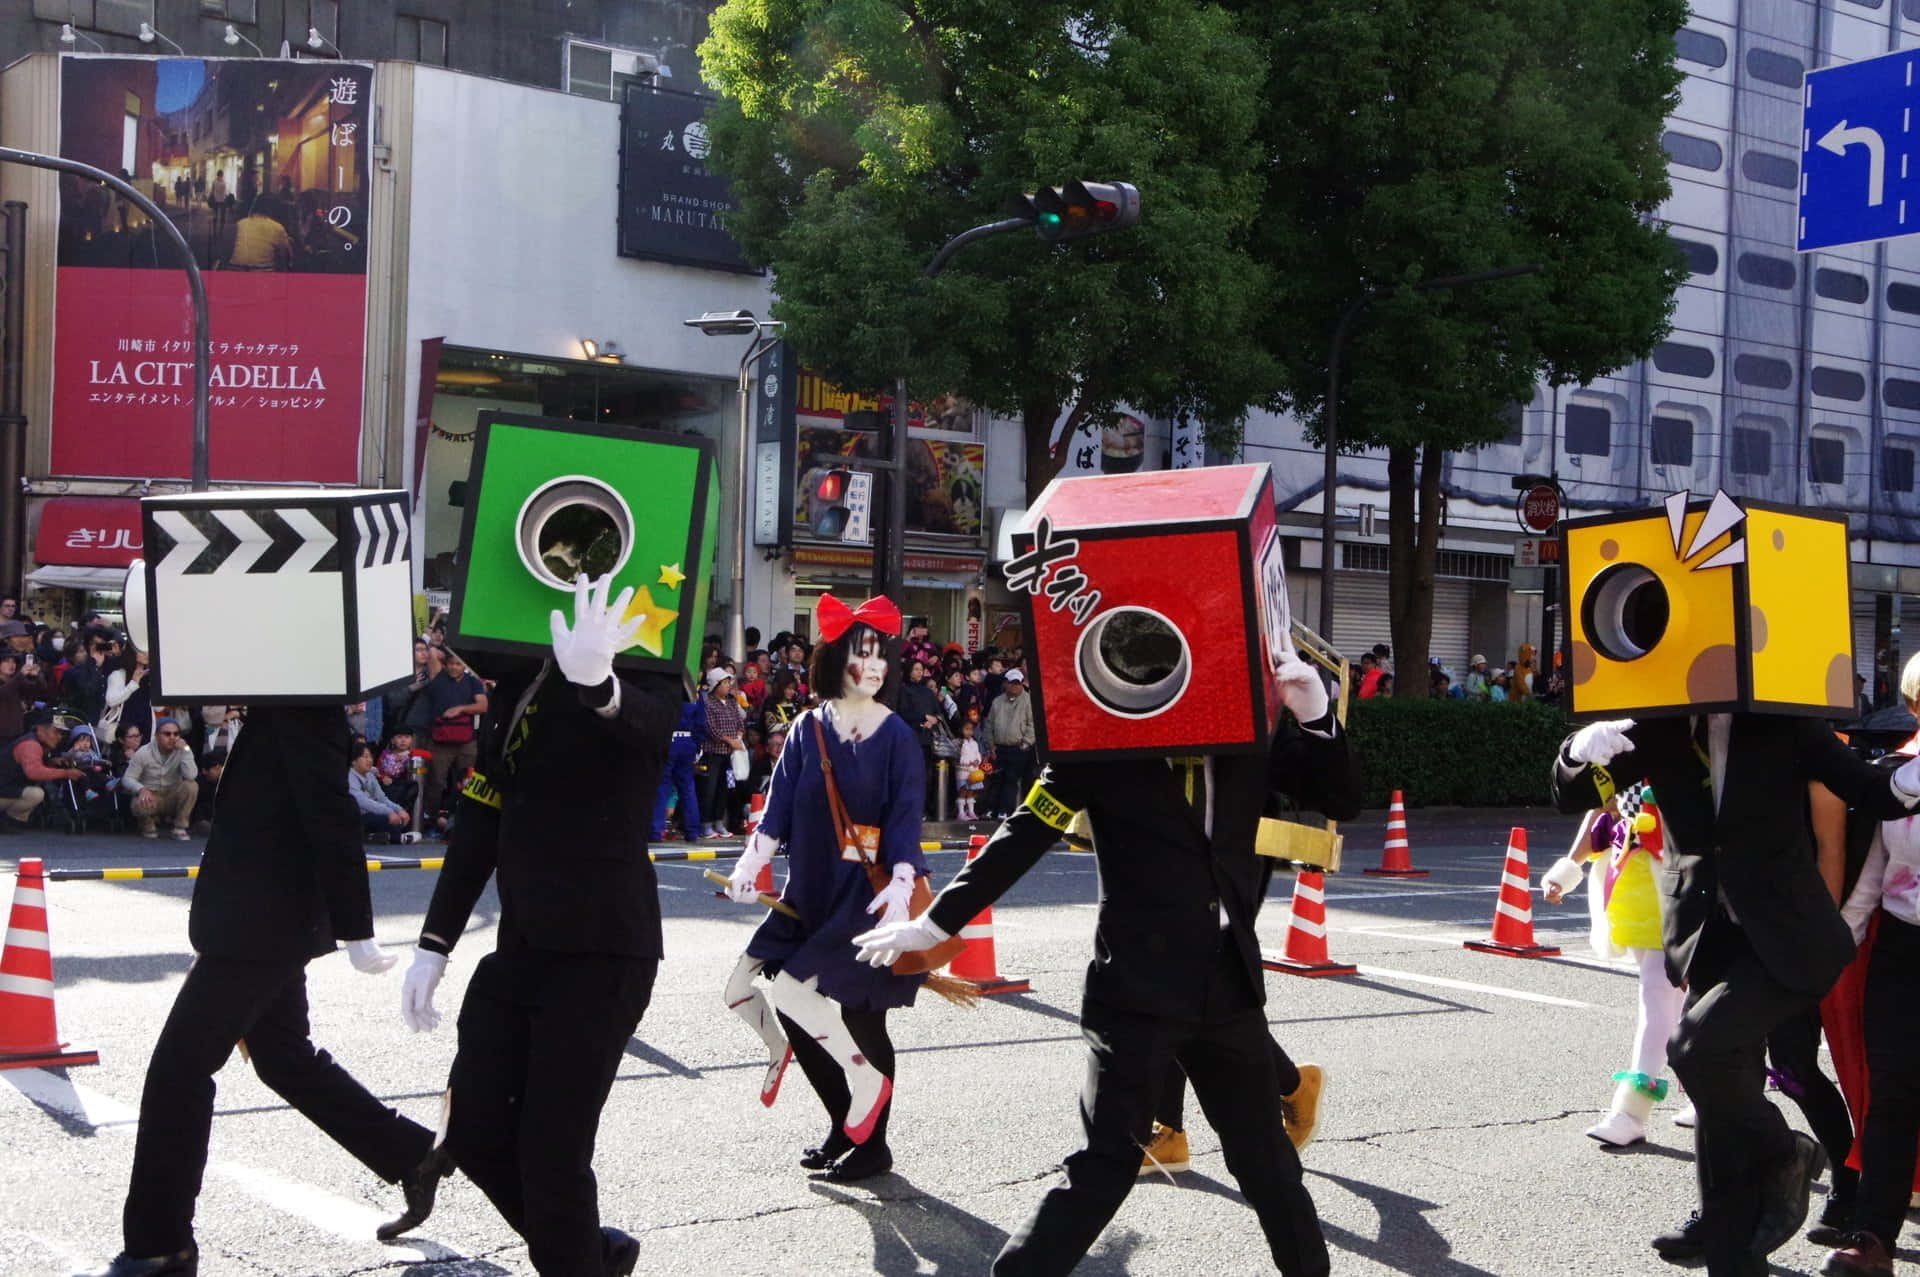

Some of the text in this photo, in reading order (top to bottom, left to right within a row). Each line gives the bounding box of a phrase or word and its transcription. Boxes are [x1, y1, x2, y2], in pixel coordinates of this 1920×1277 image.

[327, 77, 358, 251] 遊ぼーの。
[663, 193, 731, 210] BRAND SHOP
[118, 339, 156, 353] 川崎市
[89, 360, 326, 390] LA CITADELLA
[1527, 499, 1556, 517] 消火栓
[1003, 514, 1101, 625] キラッ
[1032, 793, 1061, 818] KEEP
